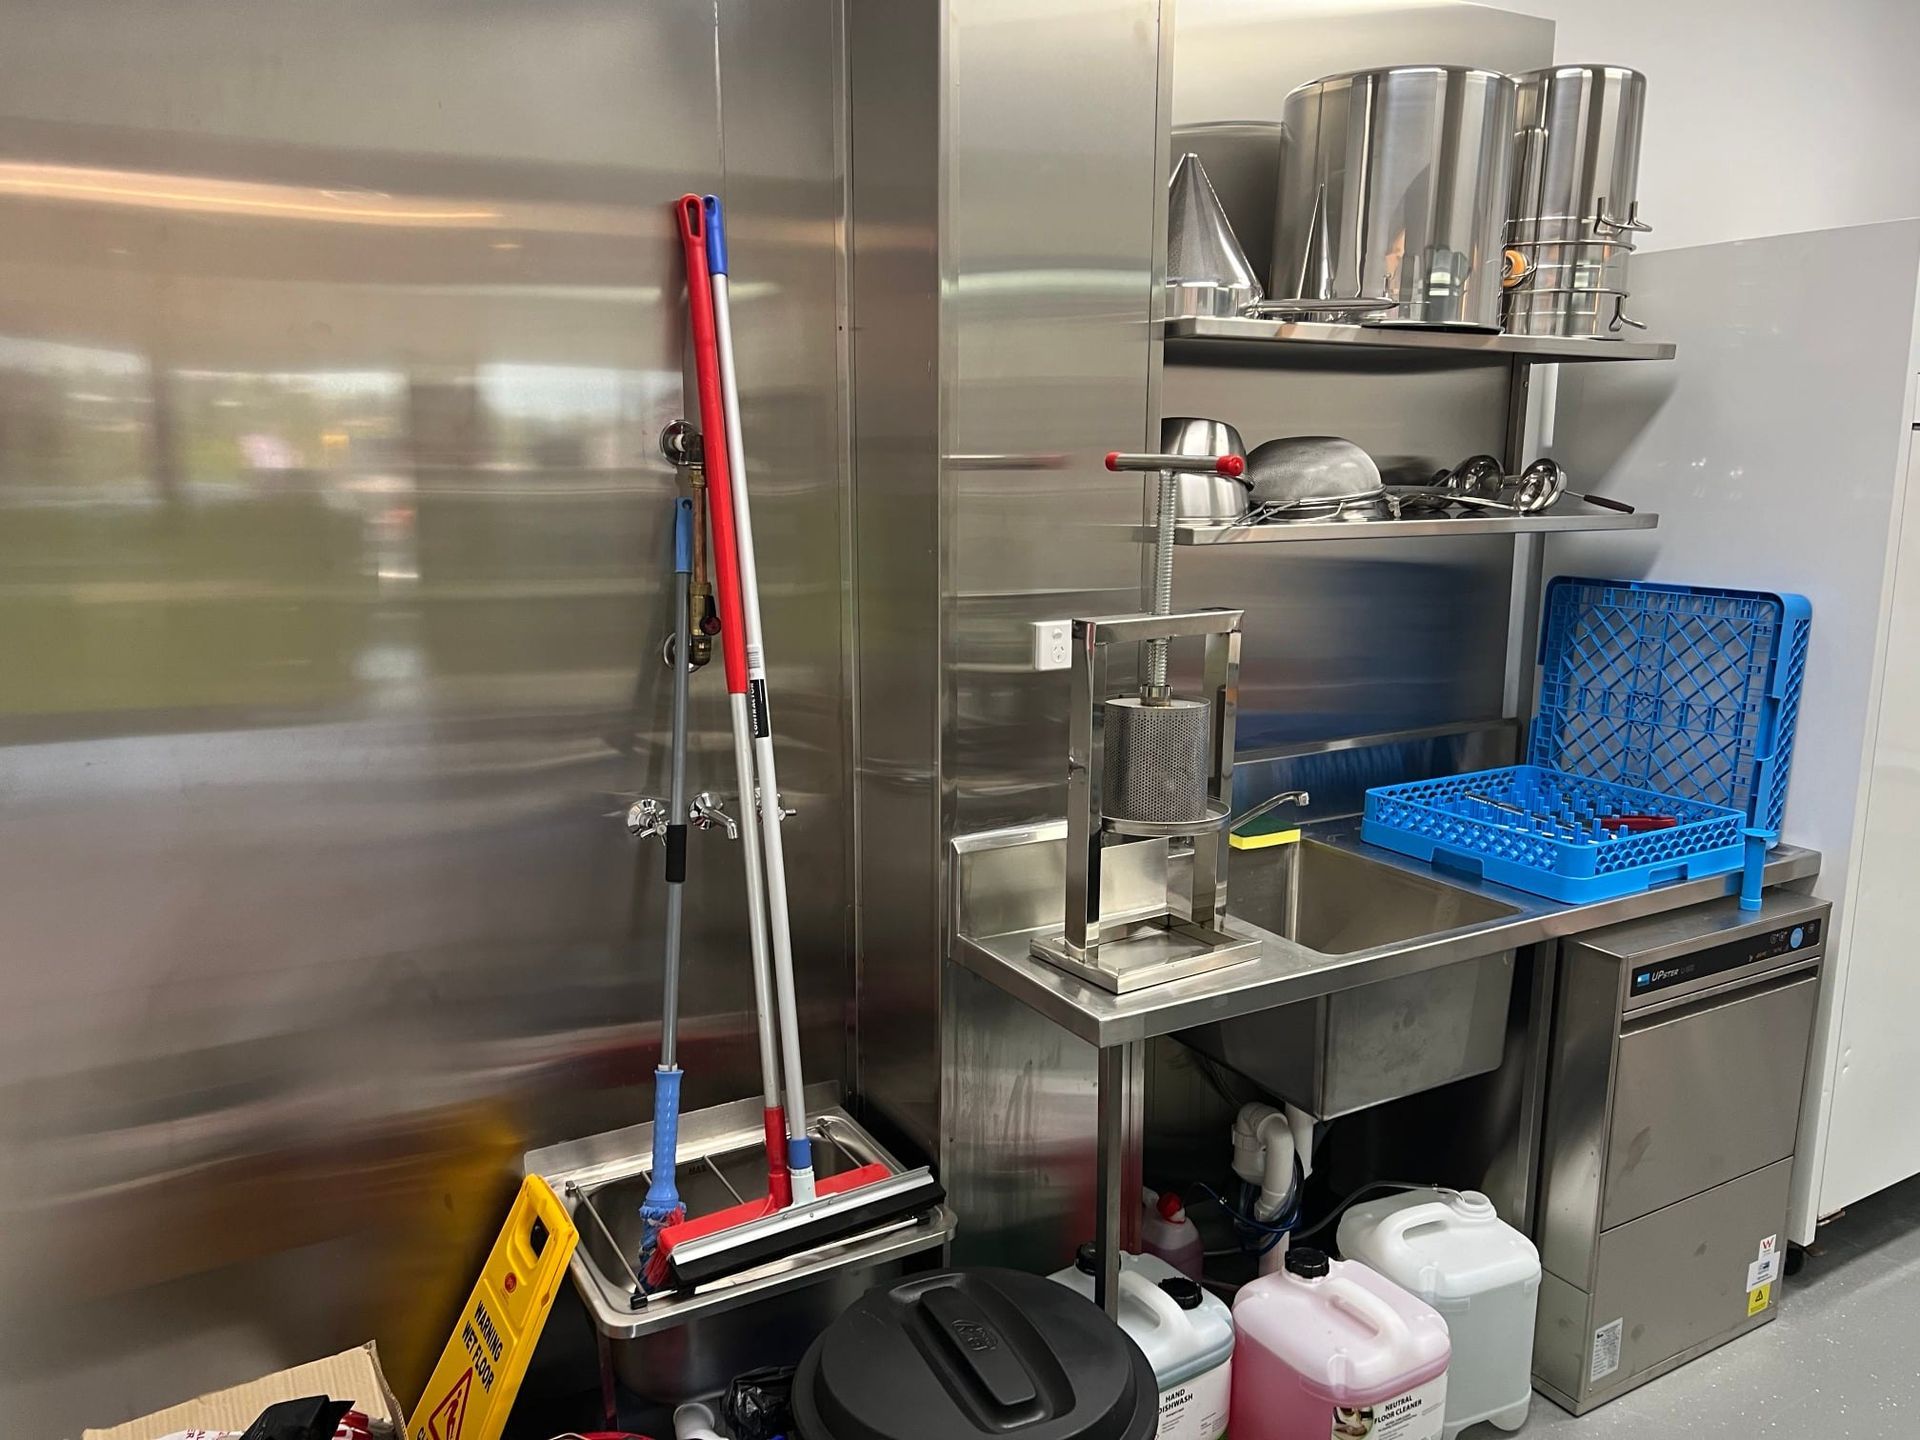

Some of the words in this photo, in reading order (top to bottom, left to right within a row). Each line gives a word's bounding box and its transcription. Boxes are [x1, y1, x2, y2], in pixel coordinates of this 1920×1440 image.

[474, 1300, 503, 1362] WARNING
[462, 1320, 478, 1354] WET
[472, 1344, 495, 1394] FLOOR
[1158, 1393, 1194, 1415] DISHWASH
[1165, 1388, 1186, 1403] HAND
[1384, 1395, 1413, 1412] NEUTRAL
[1374, 1410, 1395, 1425] FLOOR
[1395, 1398, 1422, 1416] CLEANER
